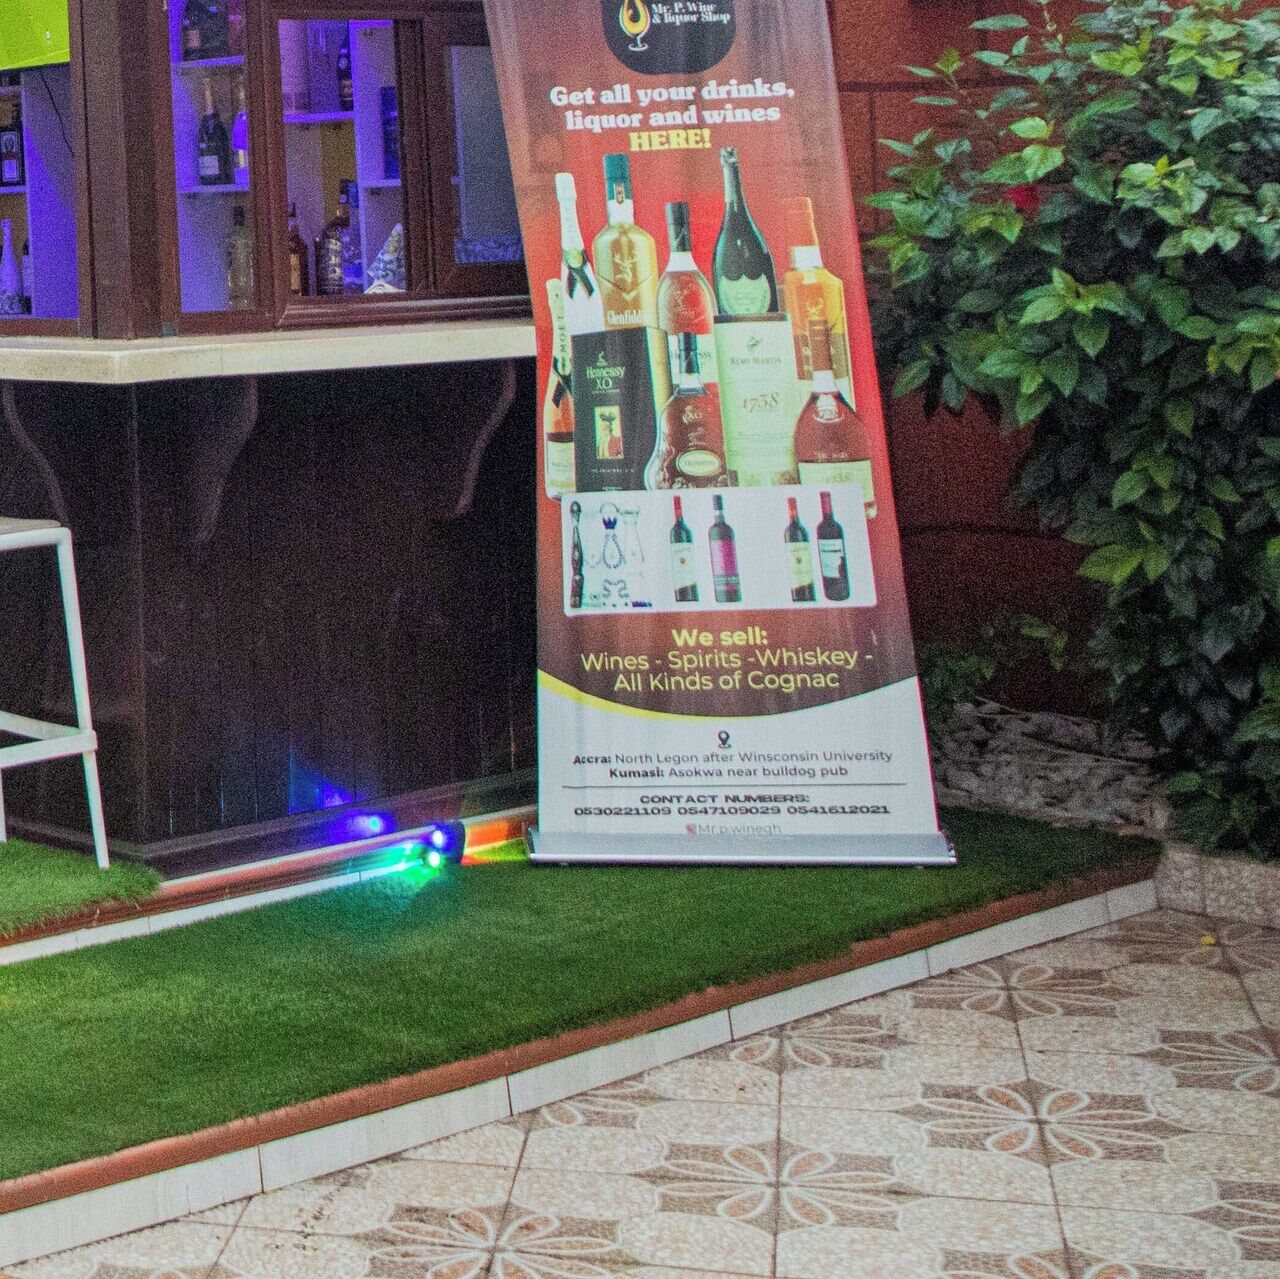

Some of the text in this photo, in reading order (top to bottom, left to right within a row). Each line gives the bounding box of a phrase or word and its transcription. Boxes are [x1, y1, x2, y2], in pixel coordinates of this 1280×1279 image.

[651, 14, 661, 24] &
[701, 11, 731, 24] Shop
[549, 86, 595, 106] Get
[600, 84, 631, 104] all
[636, 86, 696, 106] your
[565, 103, 781, 133] liquor and wines
[629, 128, 712, 151] HERE!
[672, 627, 768, 646] We sell:
[581, 652, 649, 671] Wines
[669, 649, 741, 672] Spirits
[614, 670, 839, 693] All Kinds of Cognac
[573, 750, 892, 765] Accra: North Legon after Winsconsin University
[609, 766, 848, 779] Kumasi: Asokwa near bulldog pub
[640, 794, 810, 804] CONTACT NUMBERS:
